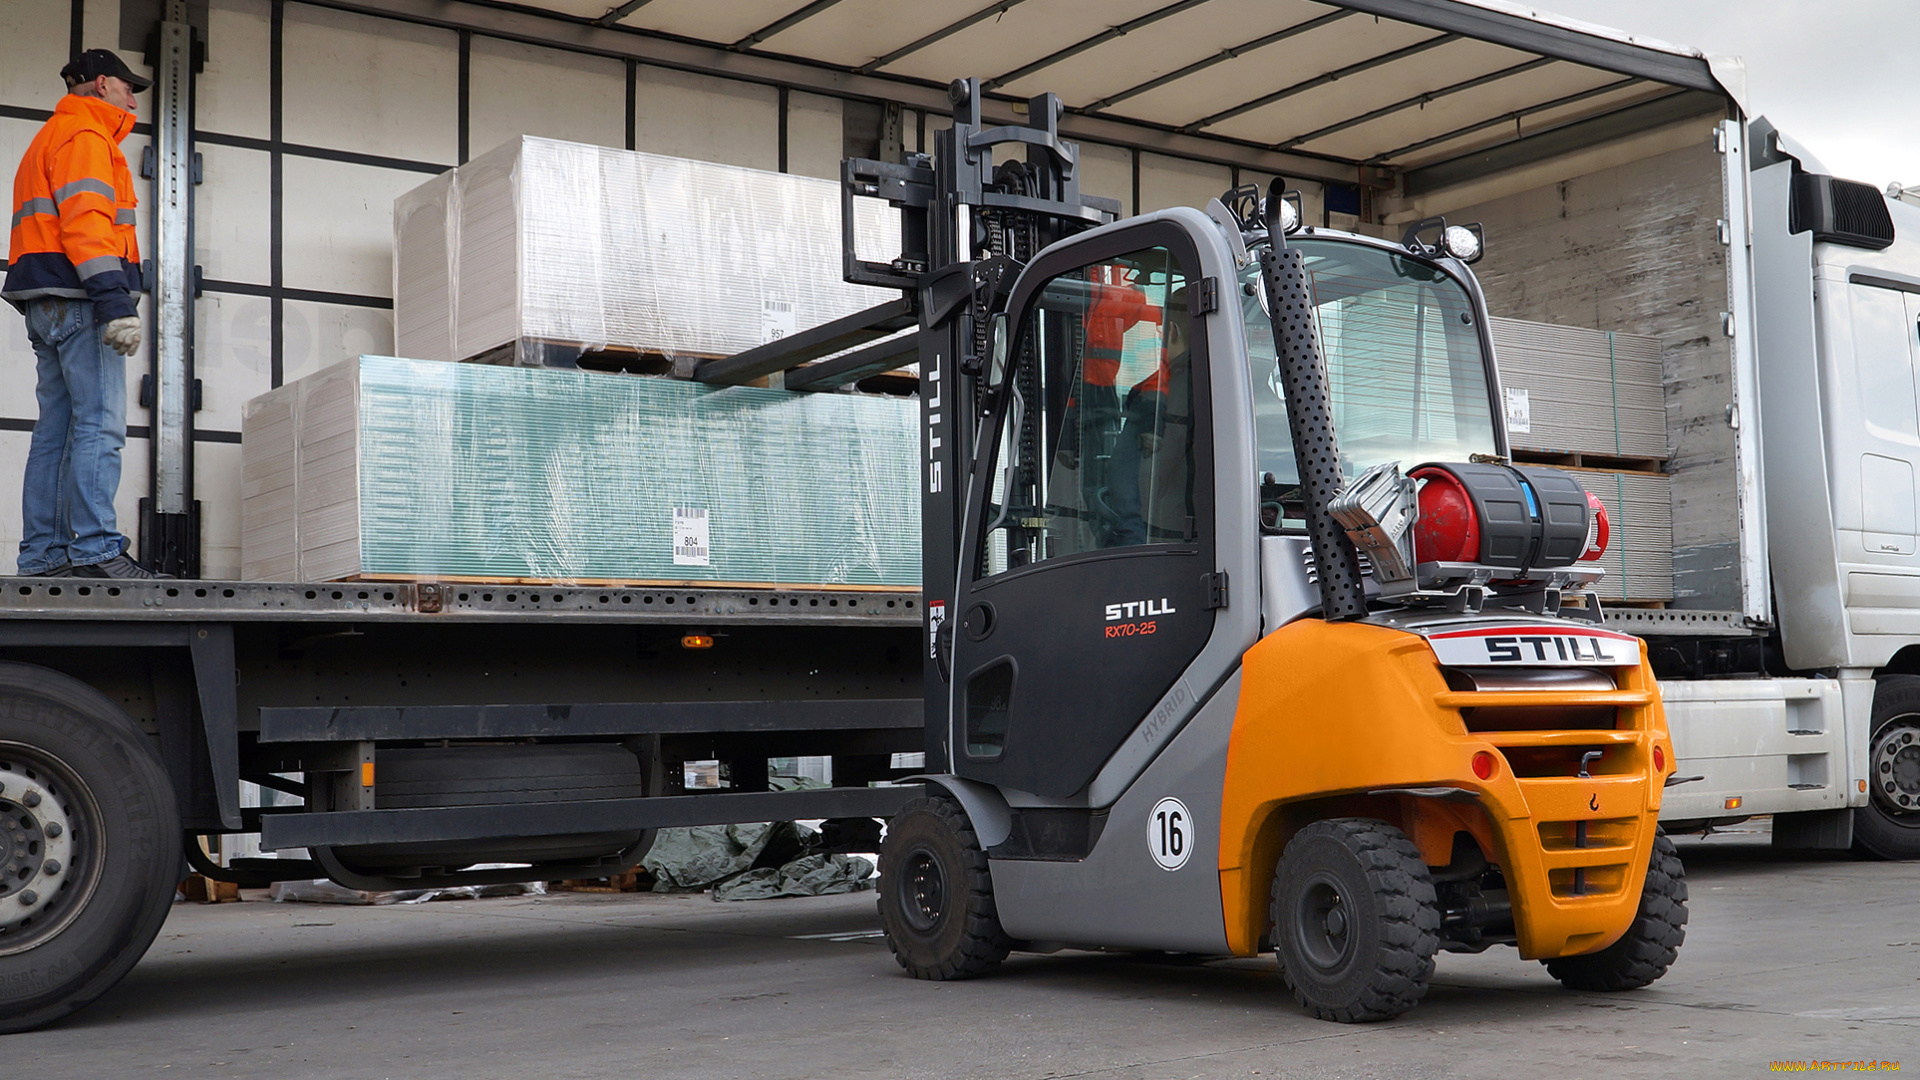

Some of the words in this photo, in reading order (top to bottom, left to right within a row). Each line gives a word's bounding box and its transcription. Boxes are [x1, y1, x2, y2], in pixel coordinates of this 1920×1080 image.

[771, 329, 784, 340] 957
[929, 354, 941, 493] STILL
[684, 536, 698, 547] 804
[1105, 598, 1176, 620] STILL
[1105, 620, 1157, 638] RX70-25
[1485, 637, 1615, 662] STILL
[1142, 688, 1185, 743] HYBRID
[1157, 811, 1183, 856] 16
